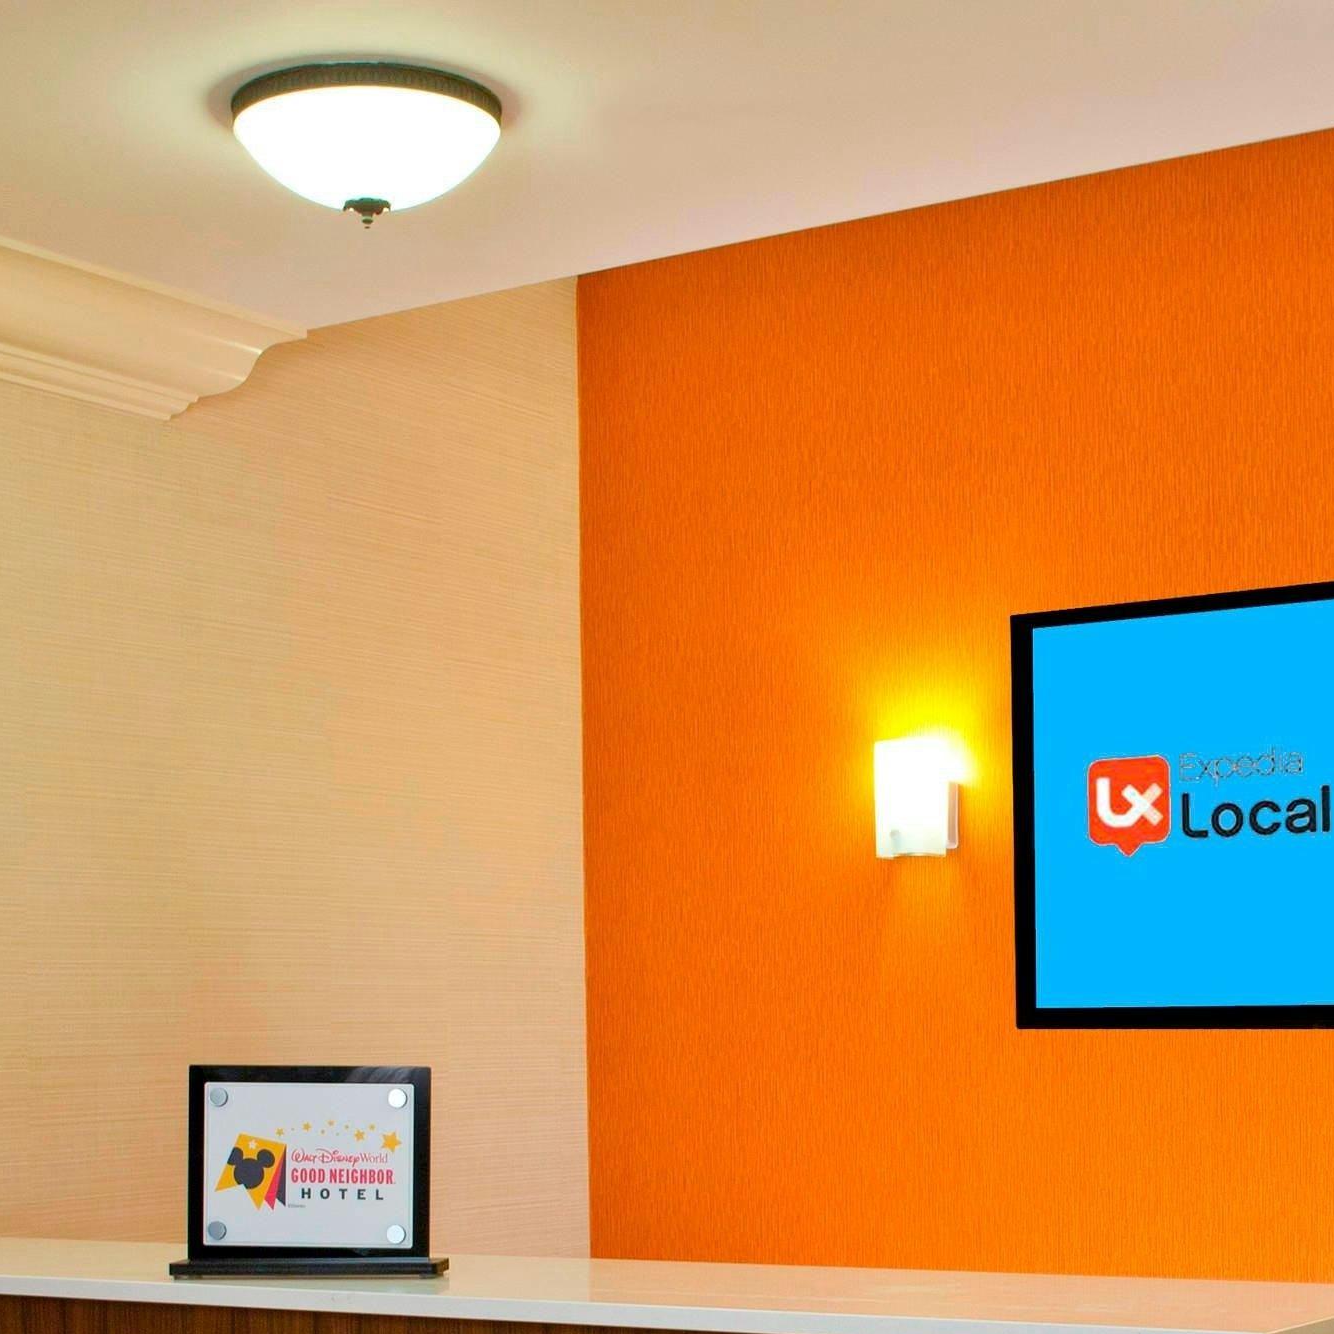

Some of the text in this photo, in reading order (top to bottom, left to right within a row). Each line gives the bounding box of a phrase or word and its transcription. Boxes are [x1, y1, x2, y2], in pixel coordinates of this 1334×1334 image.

[1178, 745, 1304, 786] Expedia
[1181, 784, 1329, 838] Local
[360, 1153, 388, 1164] World
[291, 1168, 394, 1184] GOOD NEIGHBOR
[301, 1188, 384, 1201] HOTEL
